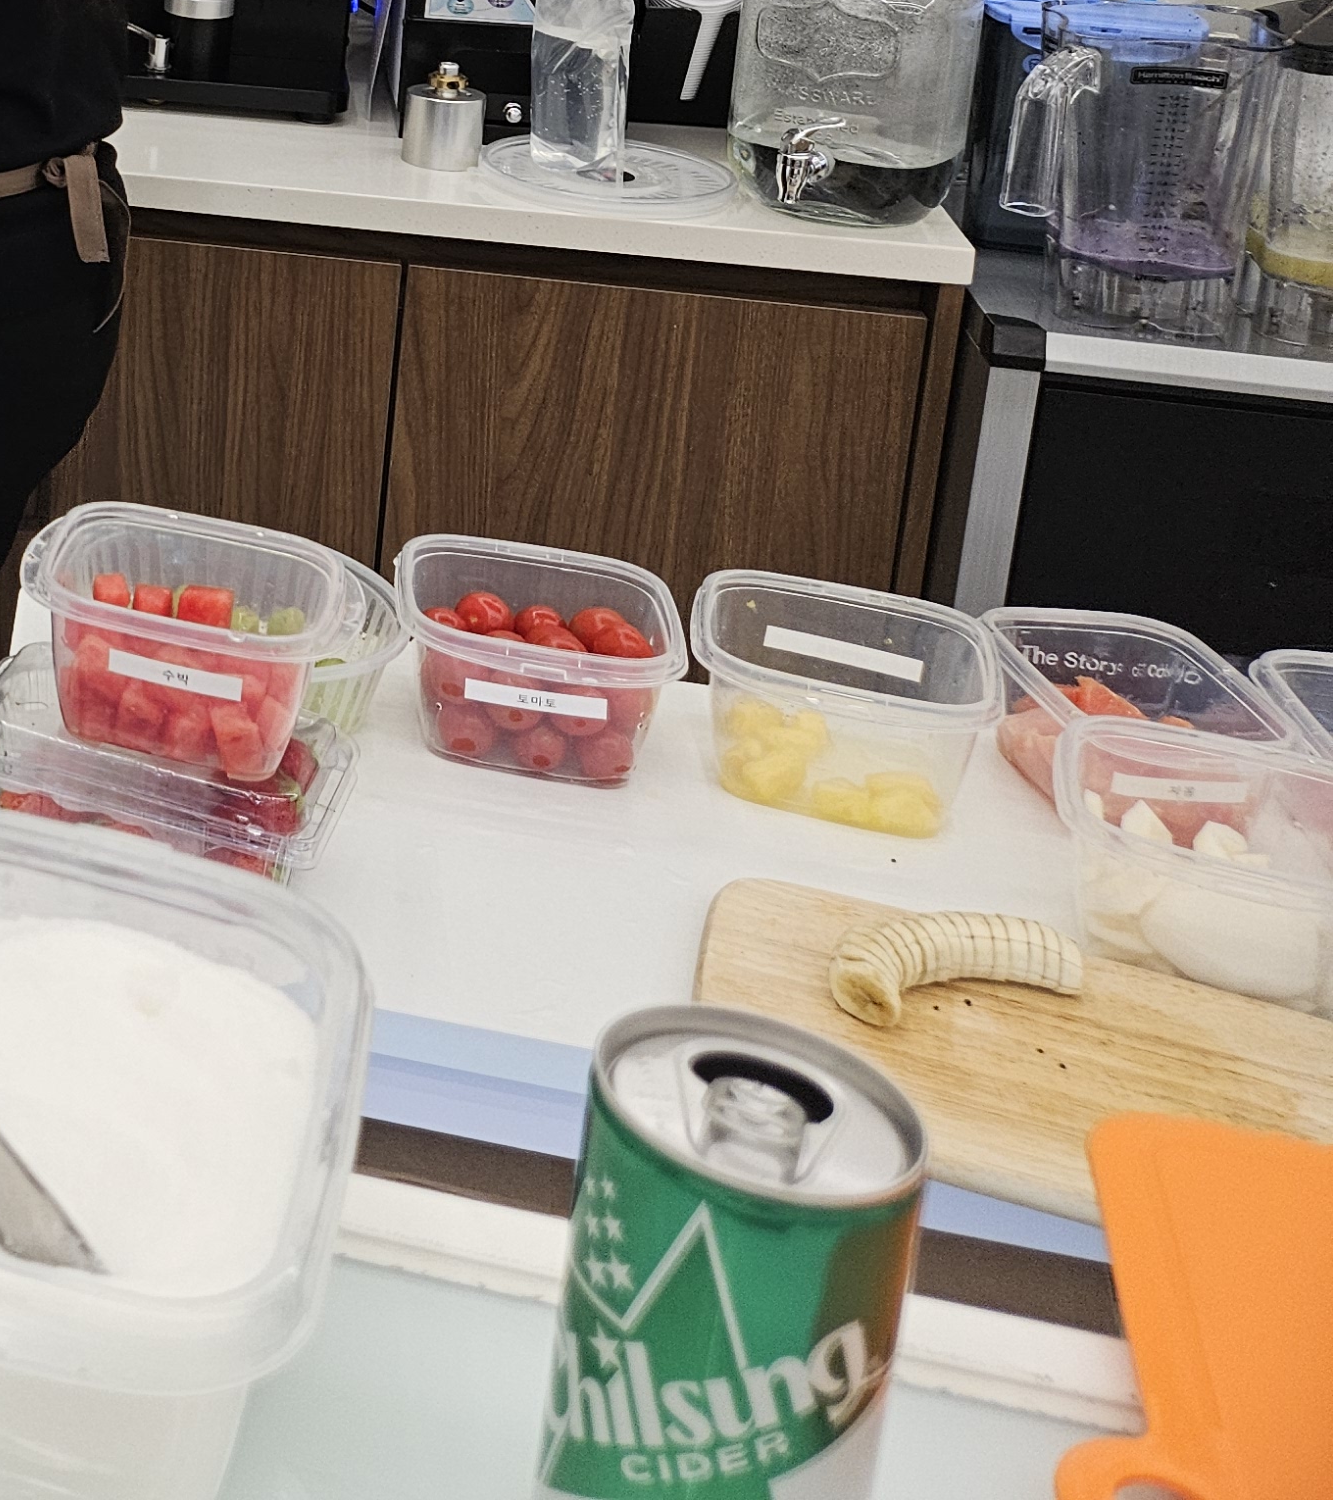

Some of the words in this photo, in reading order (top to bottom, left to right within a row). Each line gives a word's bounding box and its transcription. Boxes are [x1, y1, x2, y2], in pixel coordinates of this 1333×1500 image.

[1137, 70, 1183, 80] Hamilton
[162, 669, 189, 686] 수박
[516, 693, 557, 708] 토마토
[620, 1430, 791, 1486] CIDER
